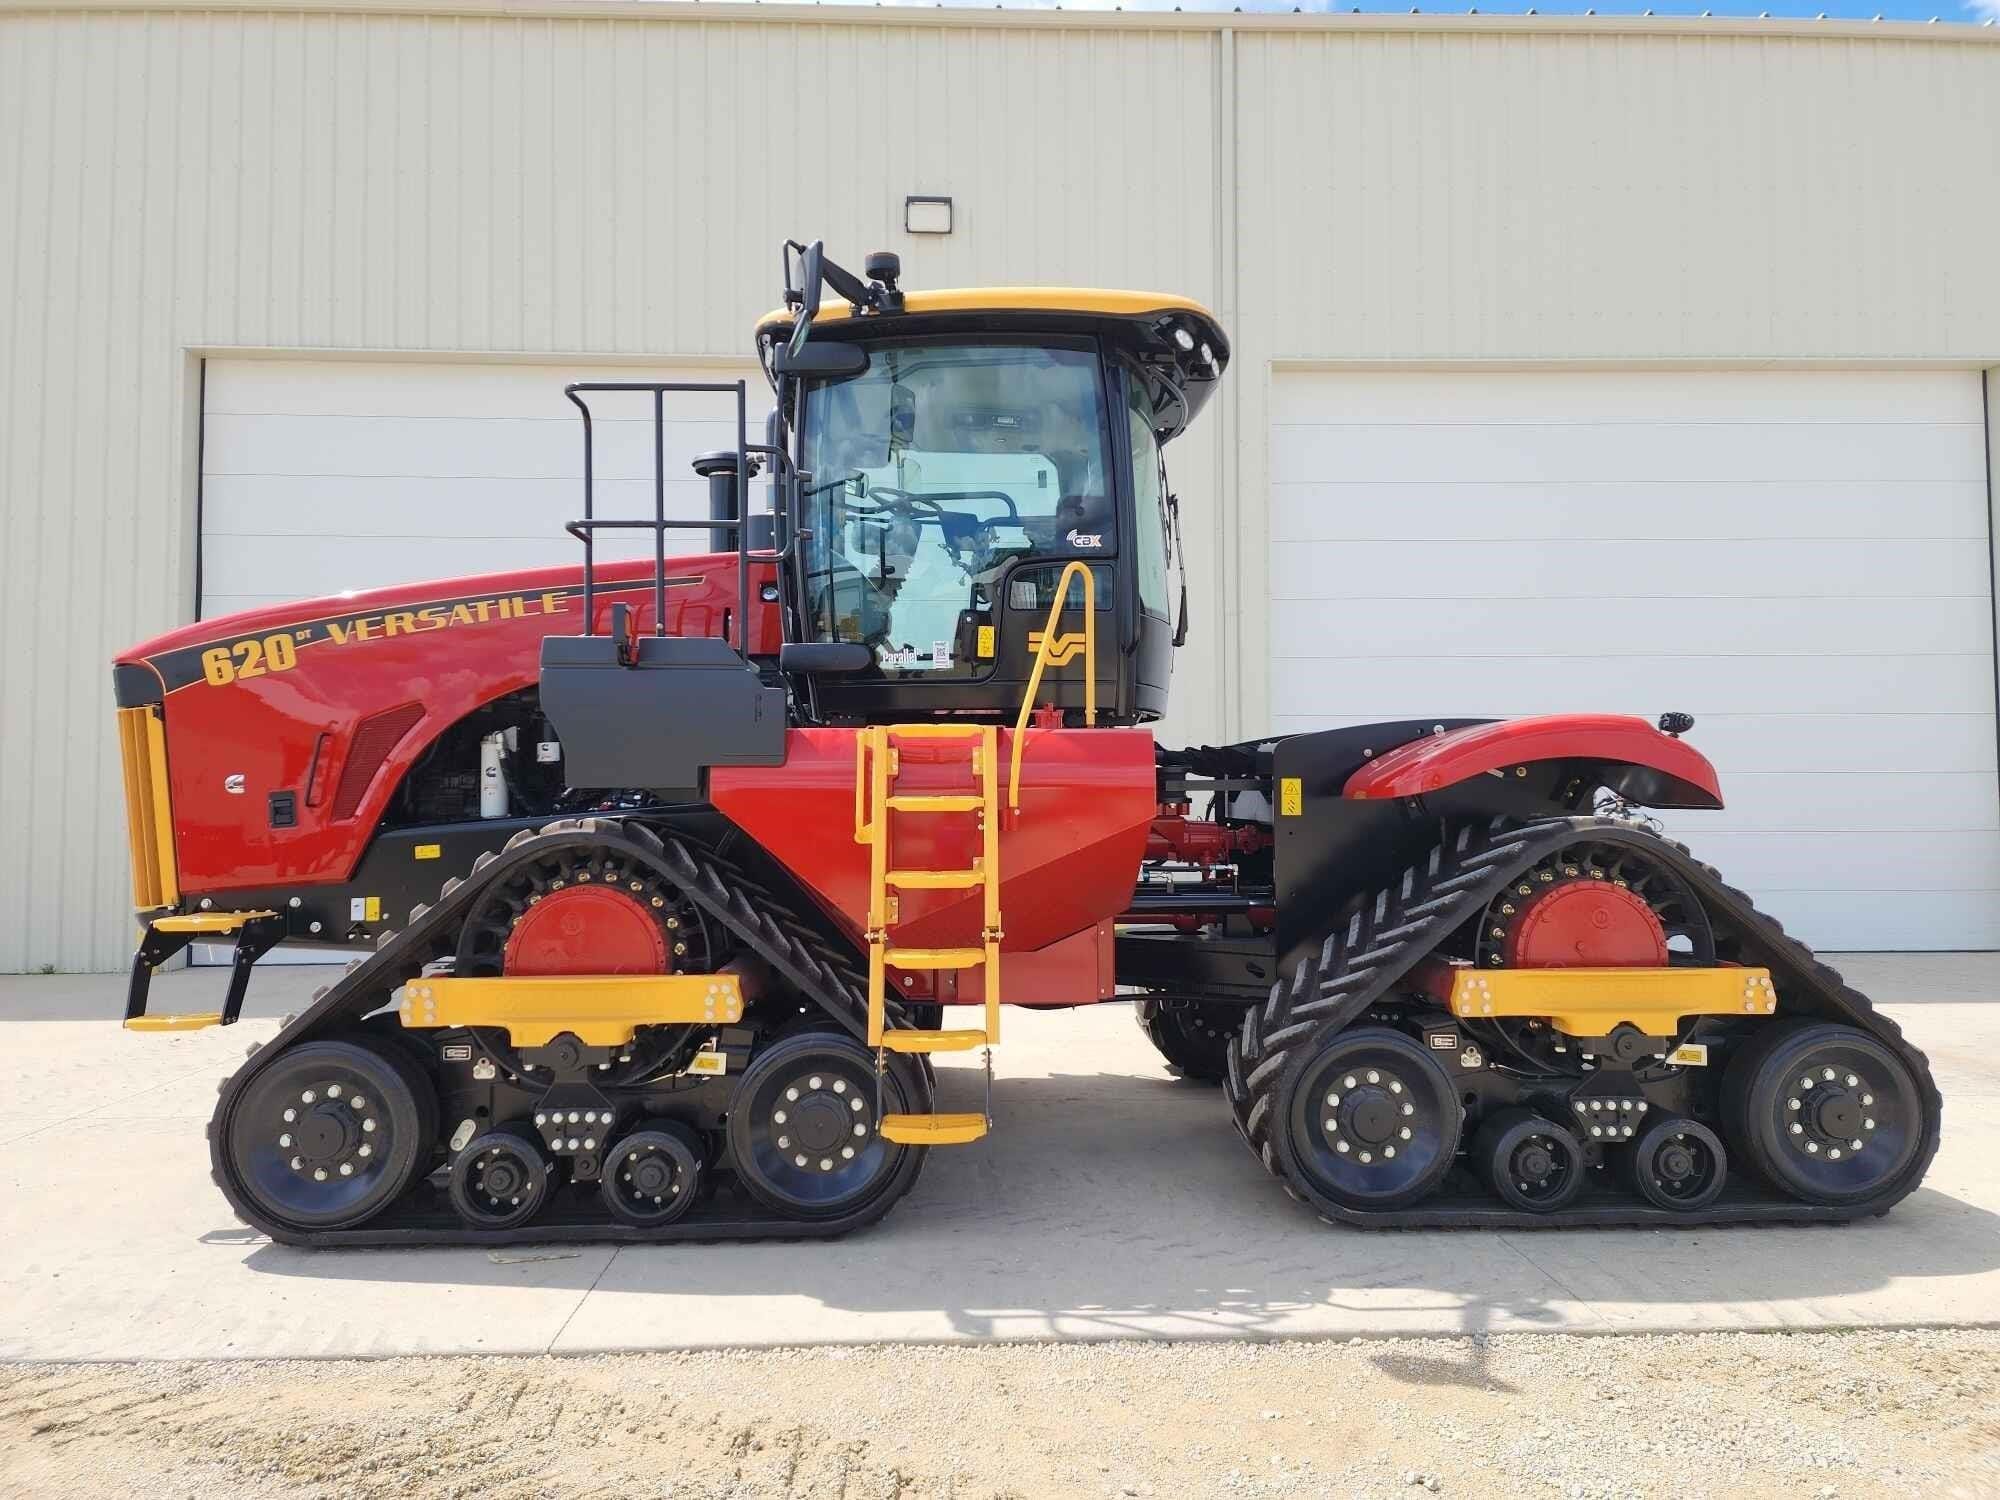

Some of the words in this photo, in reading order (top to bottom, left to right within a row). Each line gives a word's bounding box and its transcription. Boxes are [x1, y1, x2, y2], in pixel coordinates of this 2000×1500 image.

[202, 633, 297, 686] 620
[296, 629, 312, 642] DT
[326, 591, 569, 645] VERSATILE
[882, 647, 918, 664] Parallel
